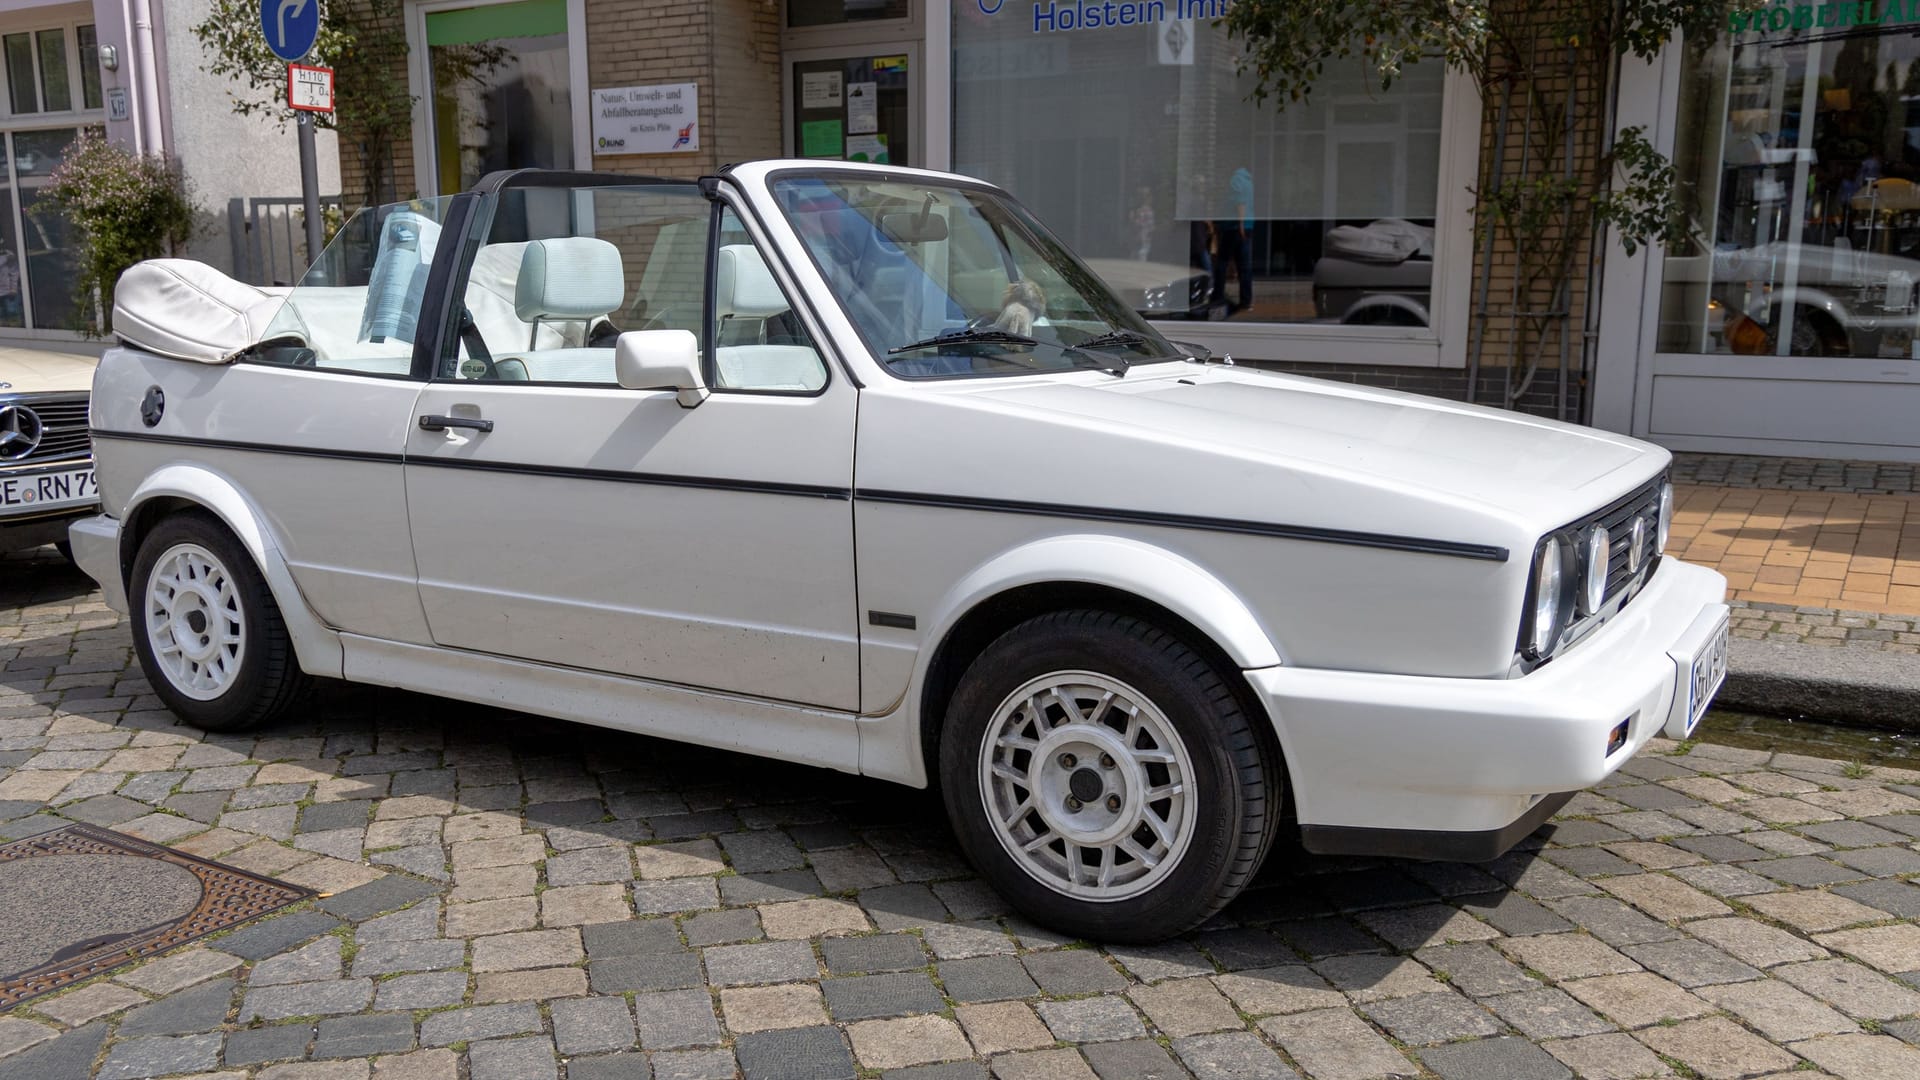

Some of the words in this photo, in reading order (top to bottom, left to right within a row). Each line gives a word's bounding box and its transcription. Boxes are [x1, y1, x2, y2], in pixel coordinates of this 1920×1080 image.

[1034, 0, 1164, 32] Holstein
[601, 93, 626, 104] Natur-,
[629, 90, 664, 102] Umwelt-
[666, 88, 682, 100] und
[601, 104, 683, 119] Abfallberatungsstelle
[639, 124, 656, 133] Kreis
[606, 139, 625, 148] BUND
[0, 479, 21, 506] E
